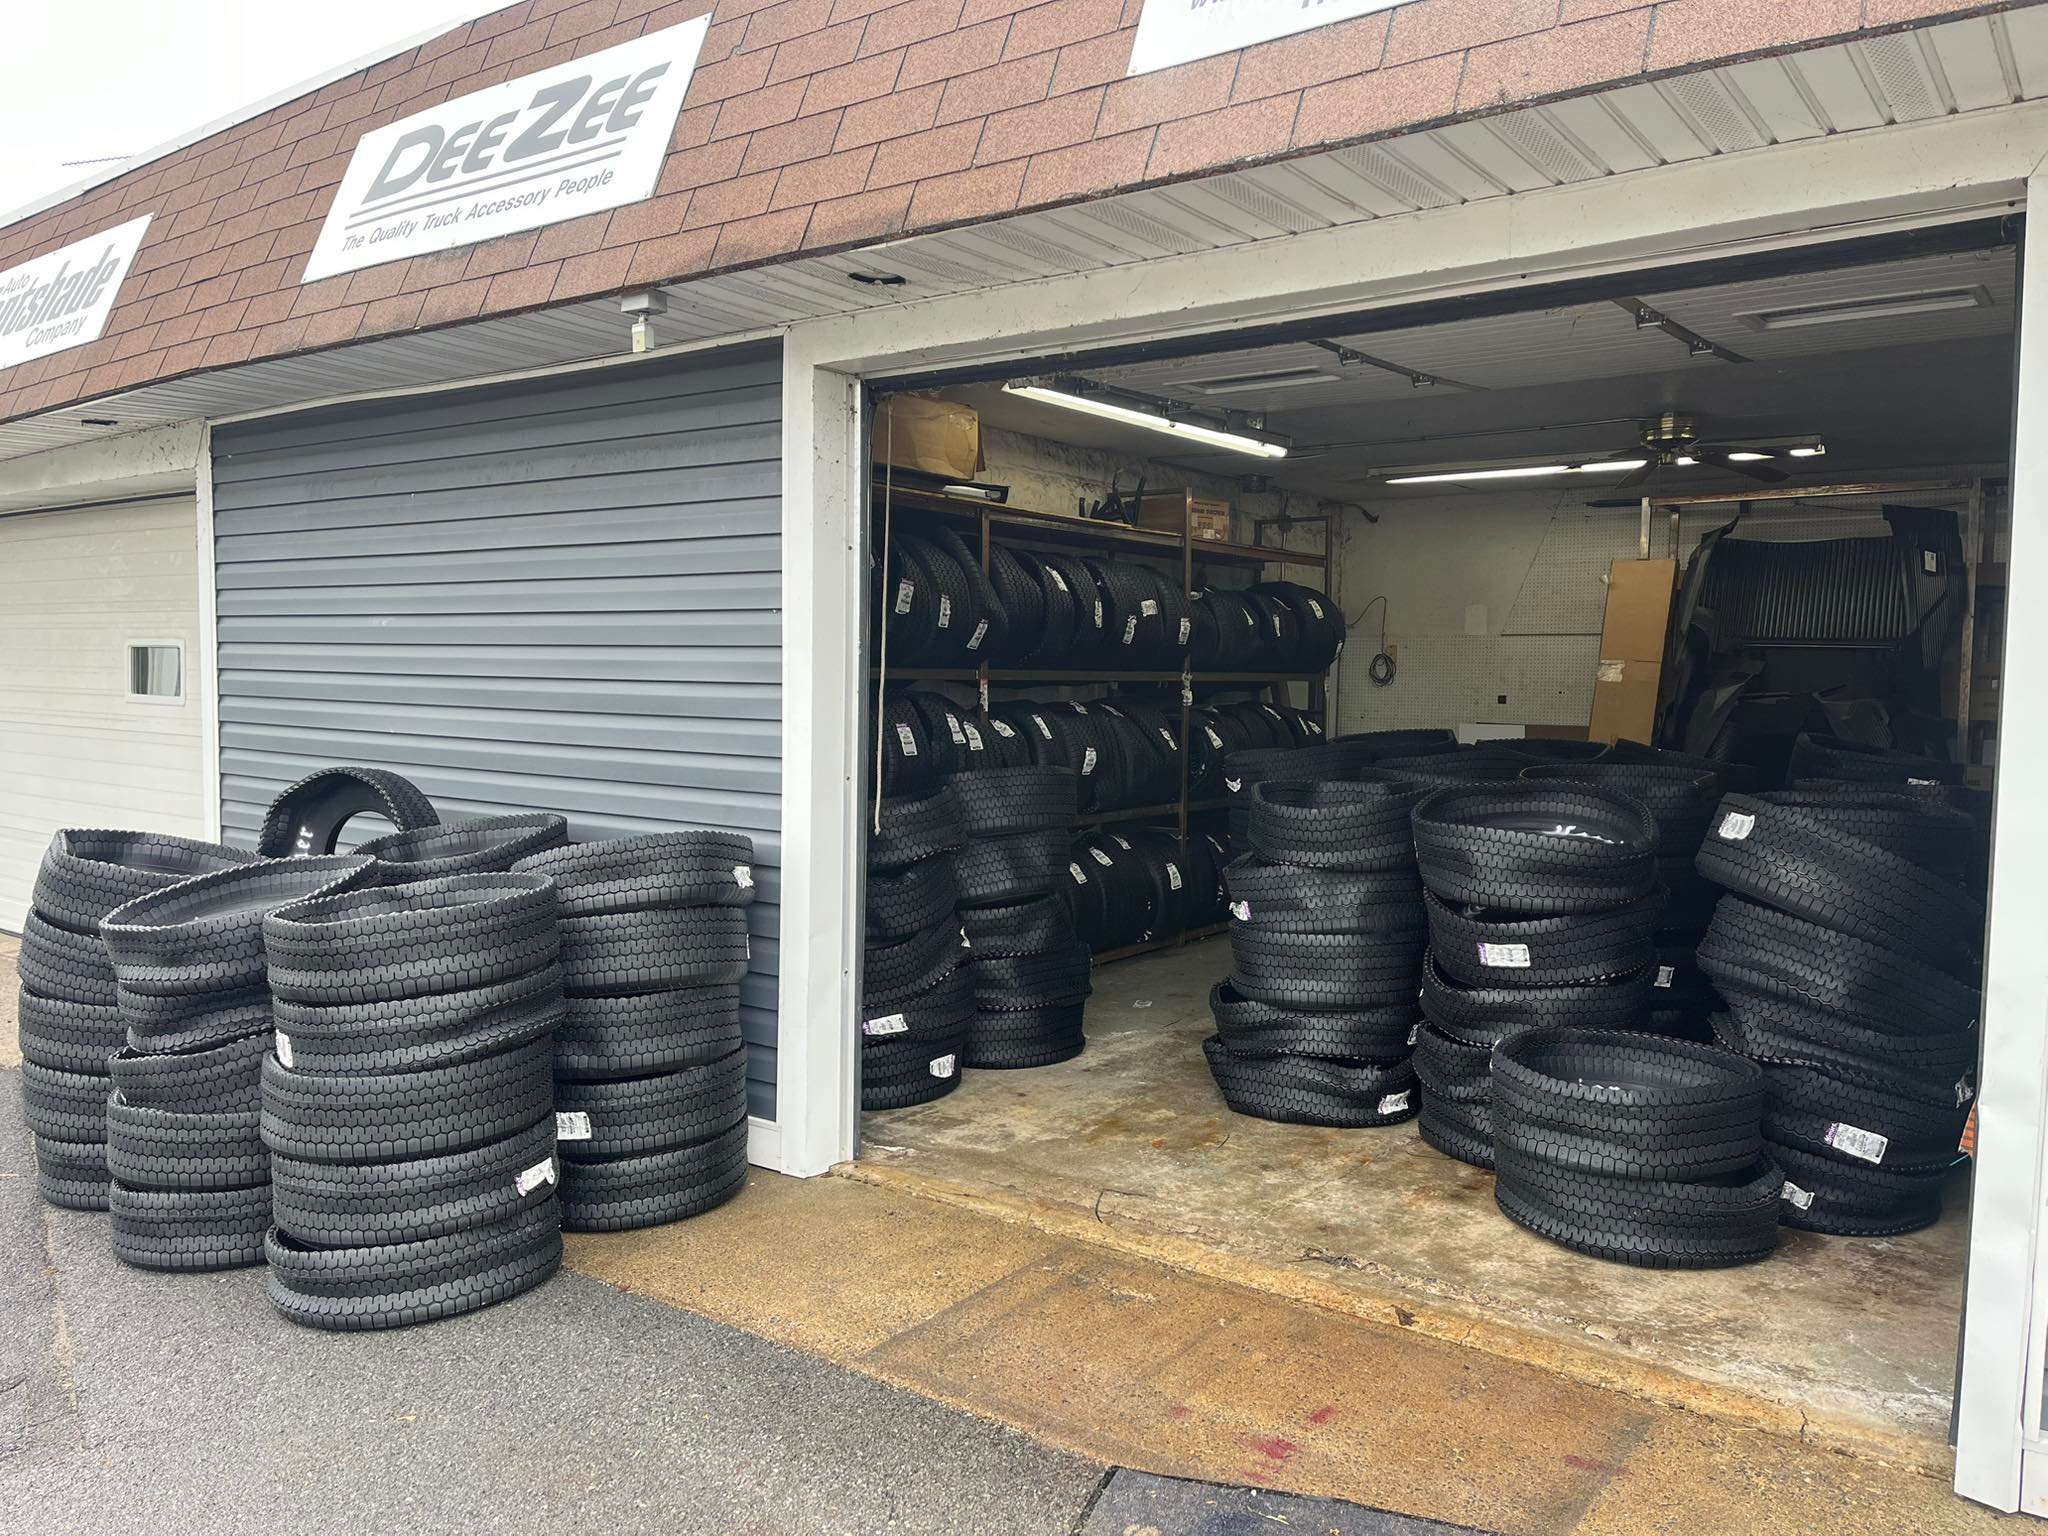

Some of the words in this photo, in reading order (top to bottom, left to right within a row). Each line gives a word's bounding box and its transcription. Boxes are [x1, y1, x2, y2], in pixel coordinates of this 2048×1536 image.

[342, 235, 364, 252] The
[369, 219, 418, 245] Quality
[422, 206, 463, 232] Truck
[465, 186, 552, 221] Accessory
[554, 168, 615, 198] People
[0, 243, 120, 336] ntshade
[3, 274, 30, 295] Auto
[25, 315, 88, 348] Company
